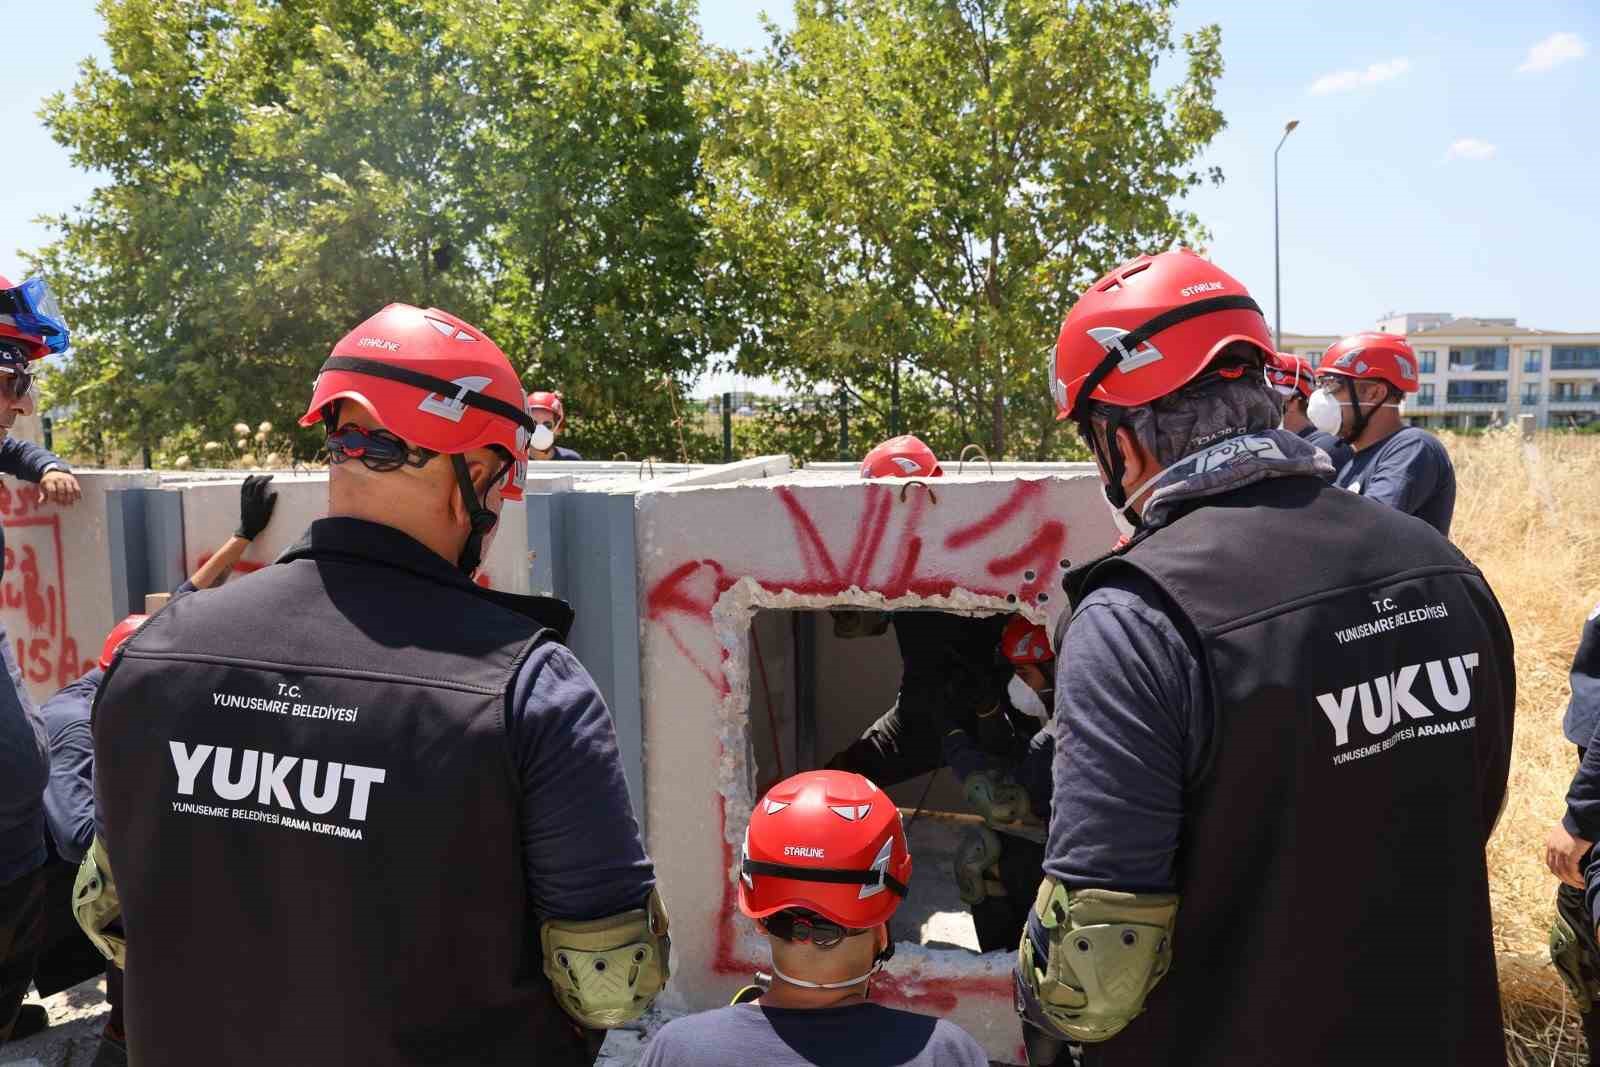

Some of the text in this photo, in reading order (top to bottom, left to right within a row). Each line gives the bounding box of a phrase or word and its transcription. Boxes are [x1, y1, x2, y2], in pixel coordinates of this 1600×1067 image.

[1372, 598, 1398, 613] T.C.
[1334, 616, 1395, 644] YUNUSEMRE
[277, 683, 302, 698] T.C.
[212, 693, 358, 722] YUNUSEMRE BELEDİYESİ
[1333, 742, 1382, 766] YUNUSEMRE
[1416, 721, 1460, 737] ARAMA
[169, 740, 386, 821] YUKUT
[172, 802, 229, 818] YUNUSEMRE
[281, 815, 311, 832] ARAMA
[312, 822, 363, 840] KURTARMA
[784, 846, 825, 858] STARLINE
